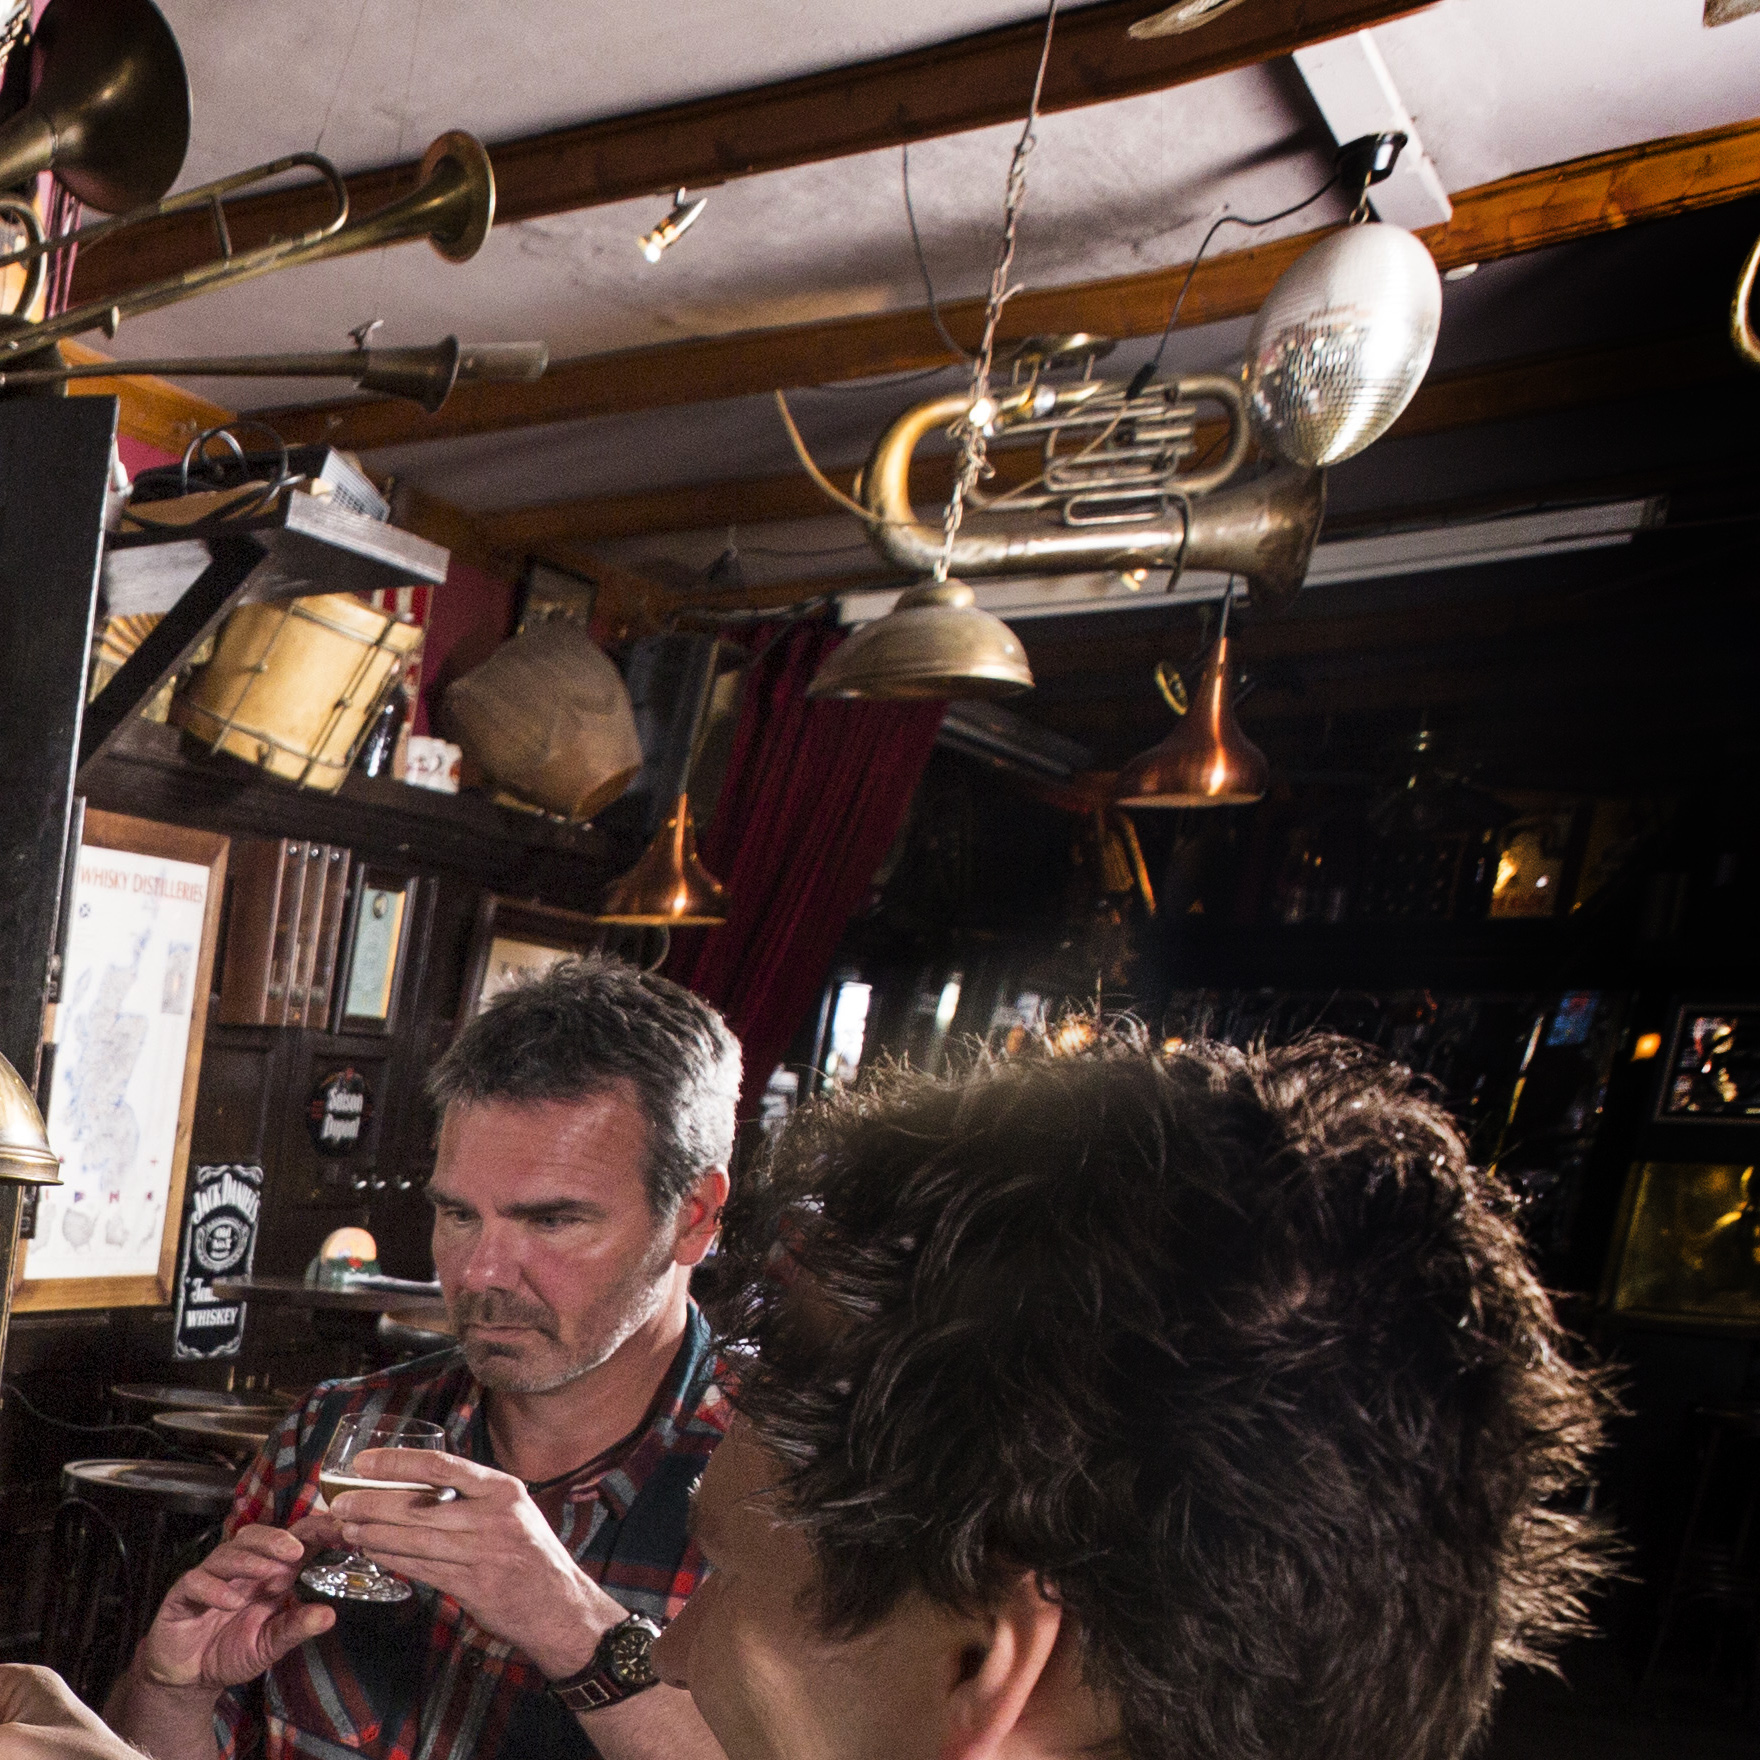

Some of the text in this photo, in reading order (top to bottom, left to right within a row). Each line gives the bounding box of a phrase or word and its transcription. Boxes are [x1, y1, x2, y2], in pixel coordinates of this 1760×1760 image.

[80, 865, 203, 903] WHISKY DISTILLERIES
[186, 1306, 239, 1328] WHISKEY
